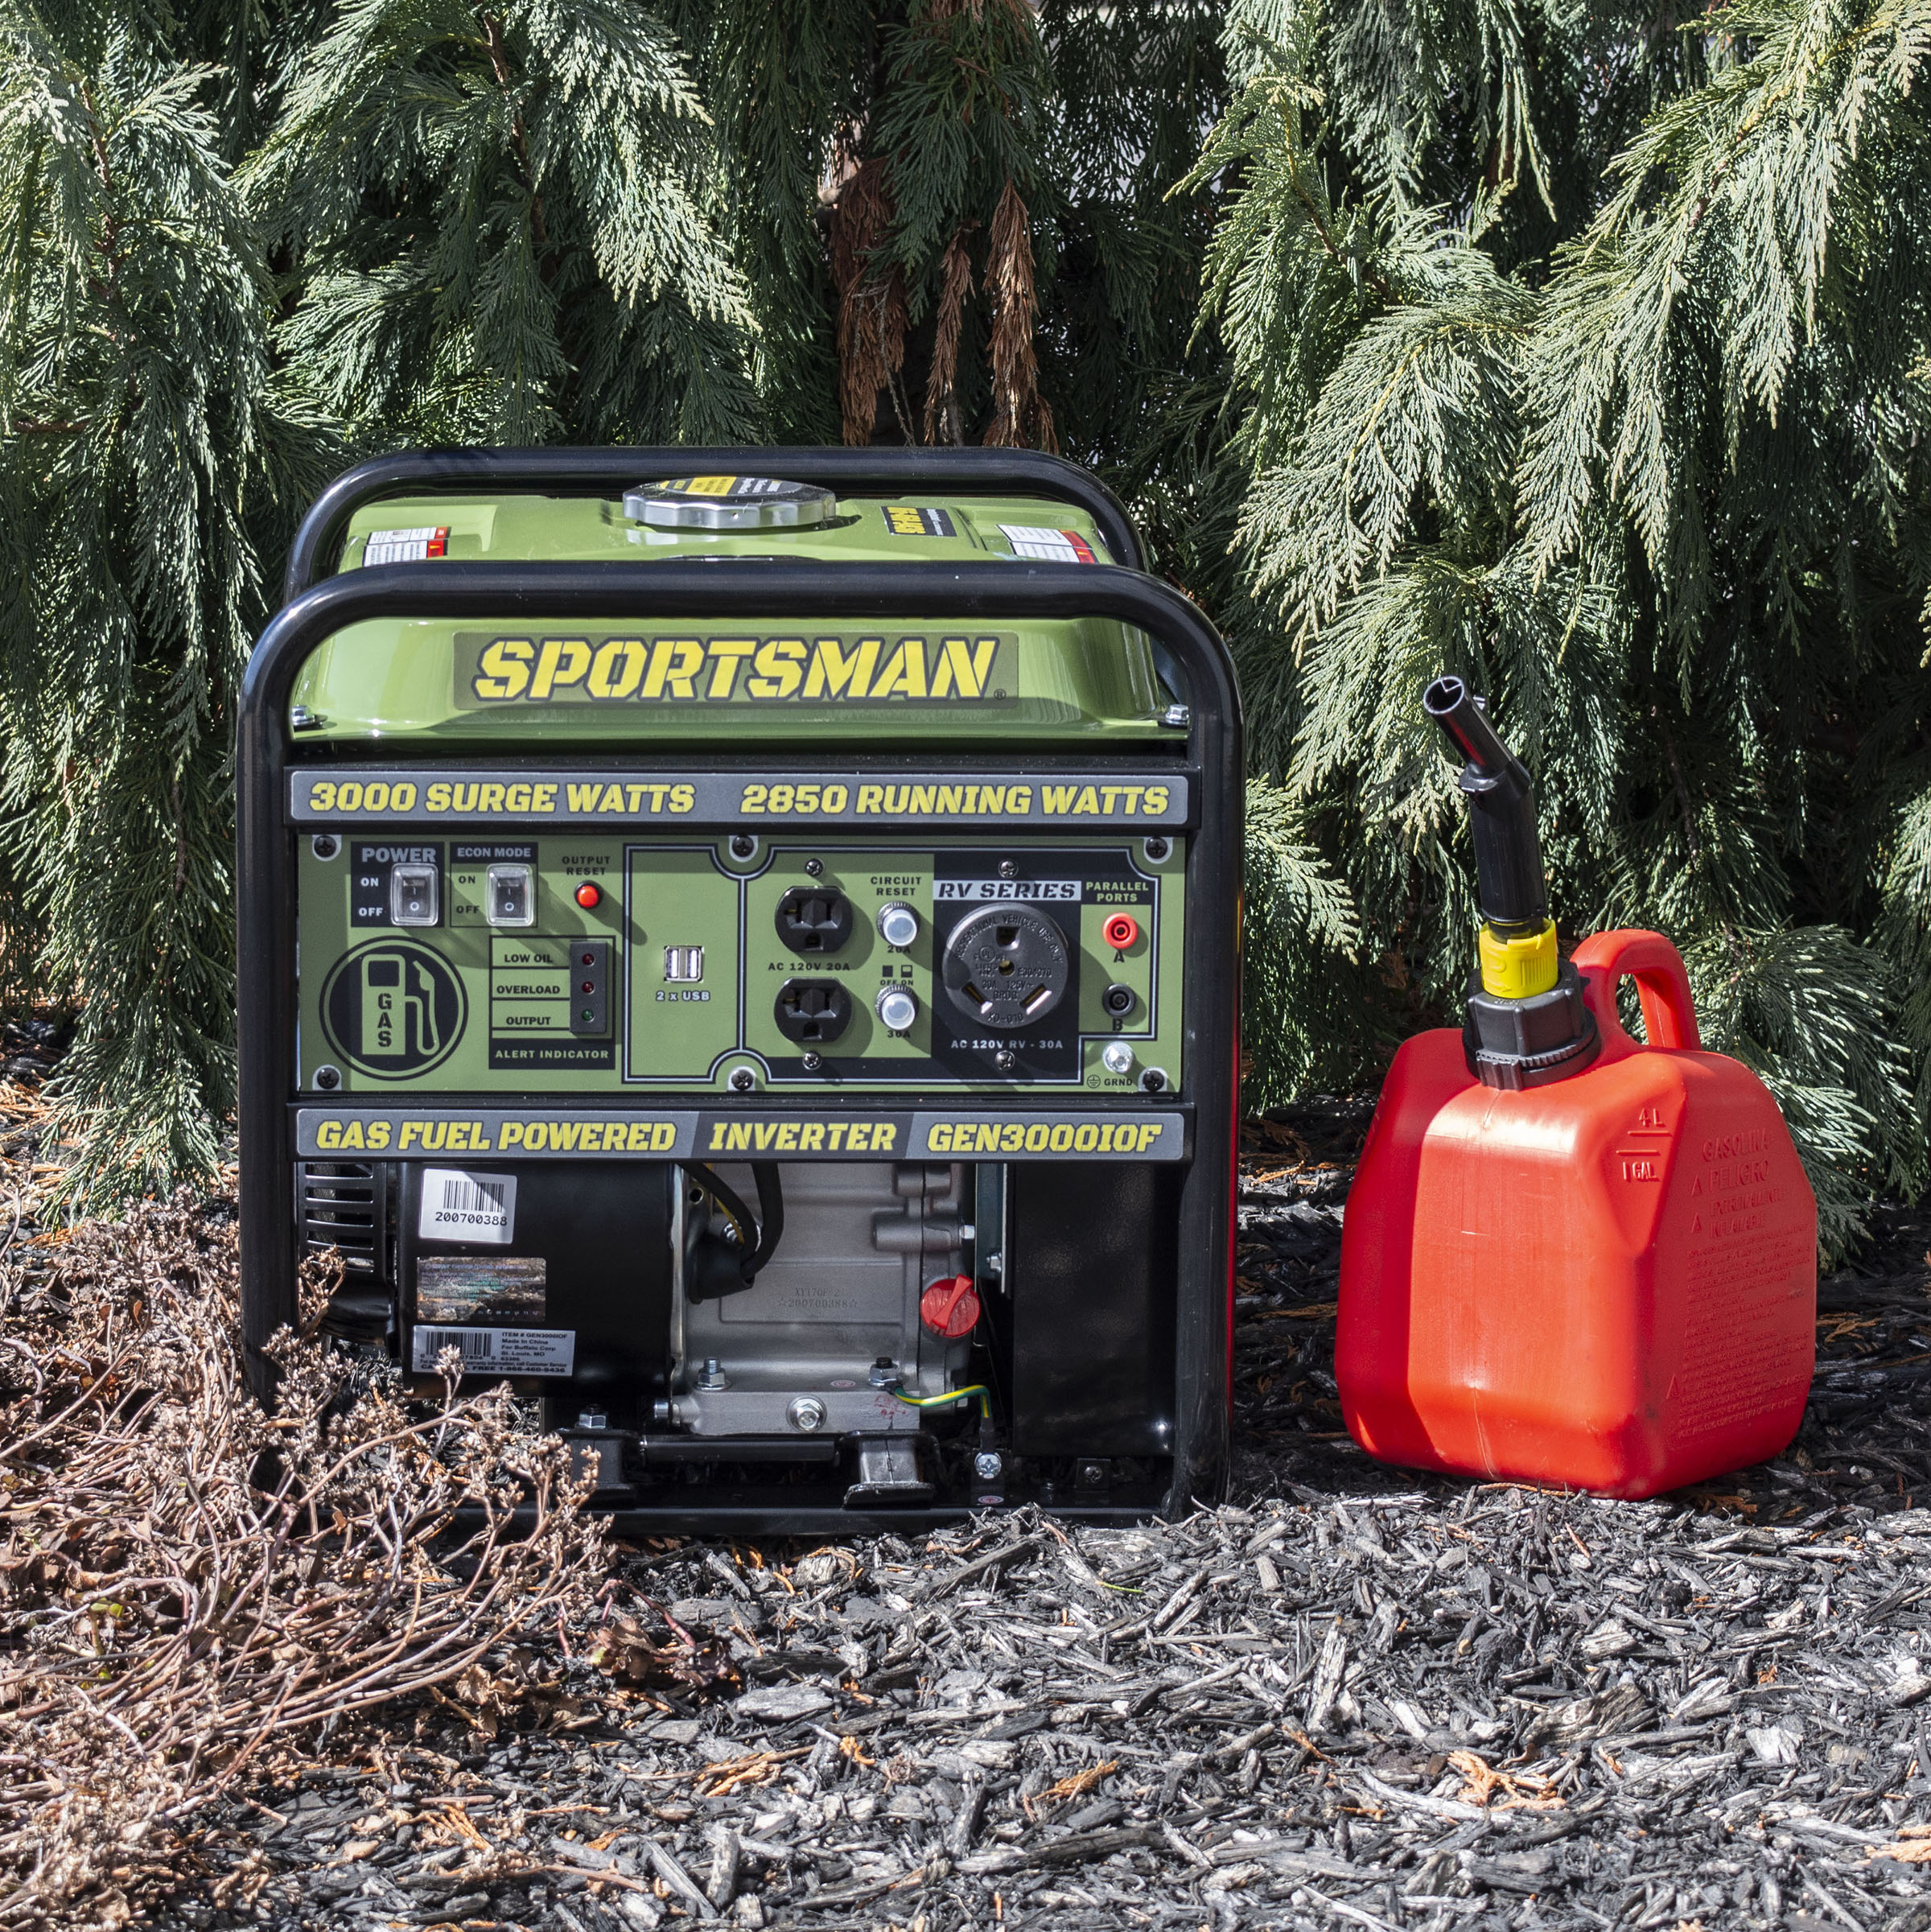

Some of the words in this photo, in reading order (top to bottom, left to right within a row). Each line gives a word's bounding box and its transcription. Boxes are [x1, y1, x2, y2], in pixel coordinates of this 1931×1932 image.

[473, 638, 999, 701] SPORTSMAN
[309, 782, 417, 814] 3000
[425, 783, 559, 814] SURGE
[566, 784, 695, 814] WATTS
[740, 784, 849, 814] 2850
[855, 785, 1031, 815] RUNNING
[1040, 785, 1171, 816] WATTS
[361, 847, 436, 863] POWER
[457, 847, 491, 858] ECON
[494, 847, 532, 858] MODE
[562, 856, 611, 865] OUTPUT
[566, 867, 607, 876] RESET
[360, 877, 379, 887] ON
[458, 875, 476, 884] ON
[870, 876, 922, 885] CIRCUIT
[875, 888, 916, 896] RESET
[938, 883, 974, 899] RV
[979, 883, 1076, 899] SERIES
[1085, 882, 1149, 892] PARALLEL
[1096, 893, 1138, 902] PORTS
[358, 907, 384, 917] OFF
[455, 905, 480, 914] OFF
[887, 945, 911, 954] 20A
[504, 954, 529, 963] LOW
[533, 954, 554, 963] OIL
[1113, 951, 1125, 963] A
[768, 962, 784, 971] AC
[789, 962, 822, 971] 120V
[826, 962, 850, 971] 20A
[496, 985, 561, 995] OVERLOAD
[656, 991, 665, 1002] 2
[669, 993, 678, 1002] x
[681, 991, 710, 1002] USB
[377, 992, 393, 1048] GAS
[505, 1016, 552, 1026] OUTPUT
[1112, 1018, 1123, 1032] B
[887, 1030, 911, 1038] 30A
[951, 1040, 967, 1049] AC
[972, 1040, 1004, 1049] 120V
[1009, 1040, 1026, 1049] RV
[1039, 1040, 1063, 1049] 30A
[495, 1049, 536, 1059] ALERT
[539, 1049, 609, 1059] INDICATOR
[1103, 1077, 1133, 1086] GRND
[316, 1121, 393, 1151] GAS
[397, 1121, 491, 1151] FUEL
[497, 1122, 677, 1151] POWERED
[709, 1123, 897, 1151] INVERTER
[1632, 1161, 1659, 1182] GAL
[1708, 1160, 1769, 1192] PELIGRO
[434, 1211, 508, 1226] 200700388
